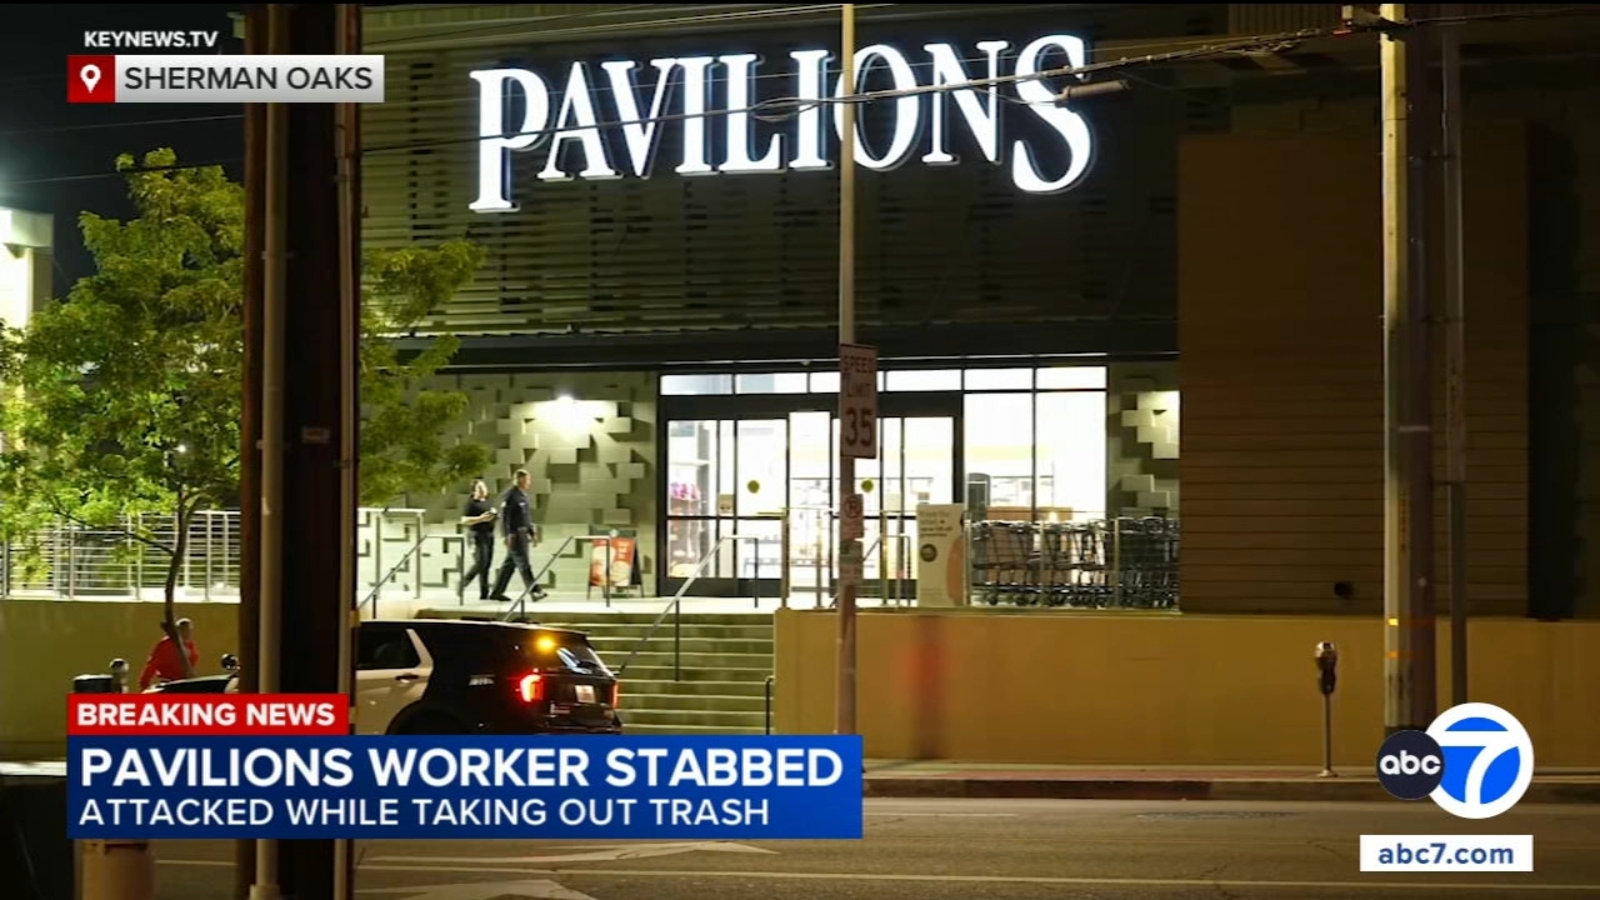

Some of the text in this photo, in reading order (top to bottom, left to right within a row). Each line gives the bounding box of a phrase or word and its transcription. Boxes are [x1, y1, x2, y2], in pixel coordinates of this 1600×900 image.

[469, 35, 1094, 212] PAVILIONS
[843, 354, 875, 374] SPEED
[846, 382, 872, 398] LIMIT
[845, 407, 873, 448] 35
